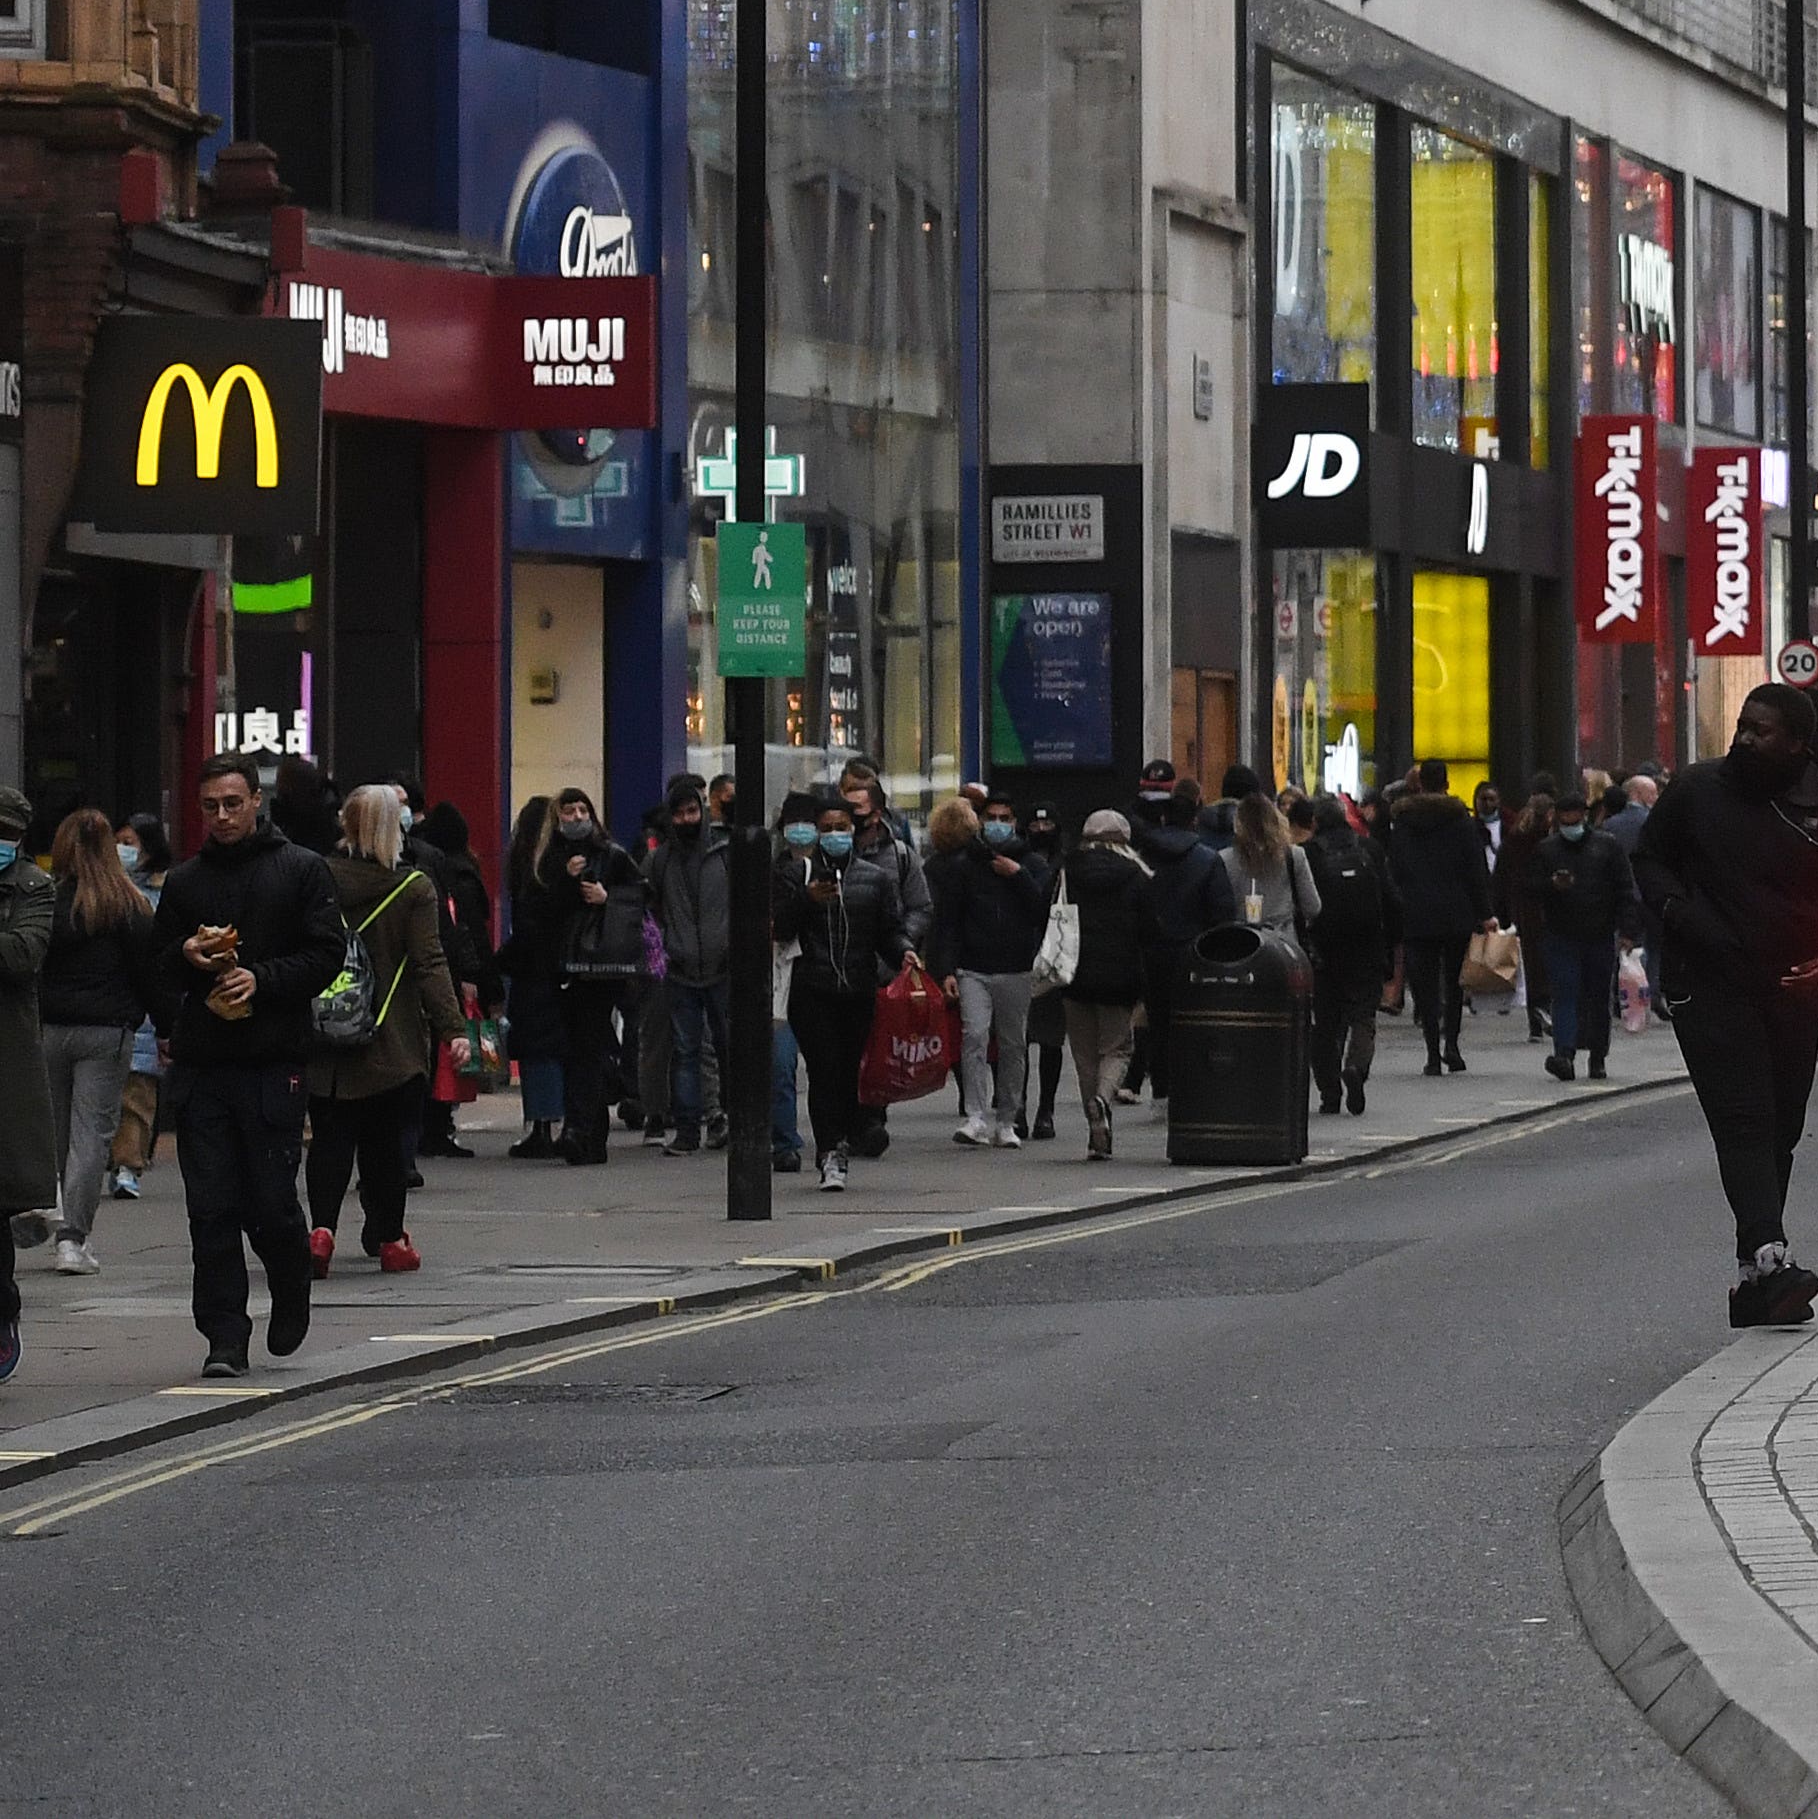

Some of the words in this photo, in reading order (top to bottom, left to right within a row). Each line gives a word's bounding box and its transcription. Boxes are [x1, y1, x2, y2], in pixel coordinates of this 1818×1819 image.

[524, 318, 625, 362] MUJI
[1267, 433, 1361, 499] JD
[1003, 502, 1092, 520] RAMILLIES
[1003, 523, 1062, 541] STREET
[1069, 523, 1092, 540] W1
[743, 604, 781, 616] PLEASE
[1032, 598, 1064, 616] We
[1067, 600, 1100, 616] are
[733, 618, 760, 630] KEEP
[762, 618, 791, 631] YOUR
[1032, 620, 1083, 638] open
[736, 632, 788, 645] DISTANCE
[1784, 653, 1817, 673] 20
